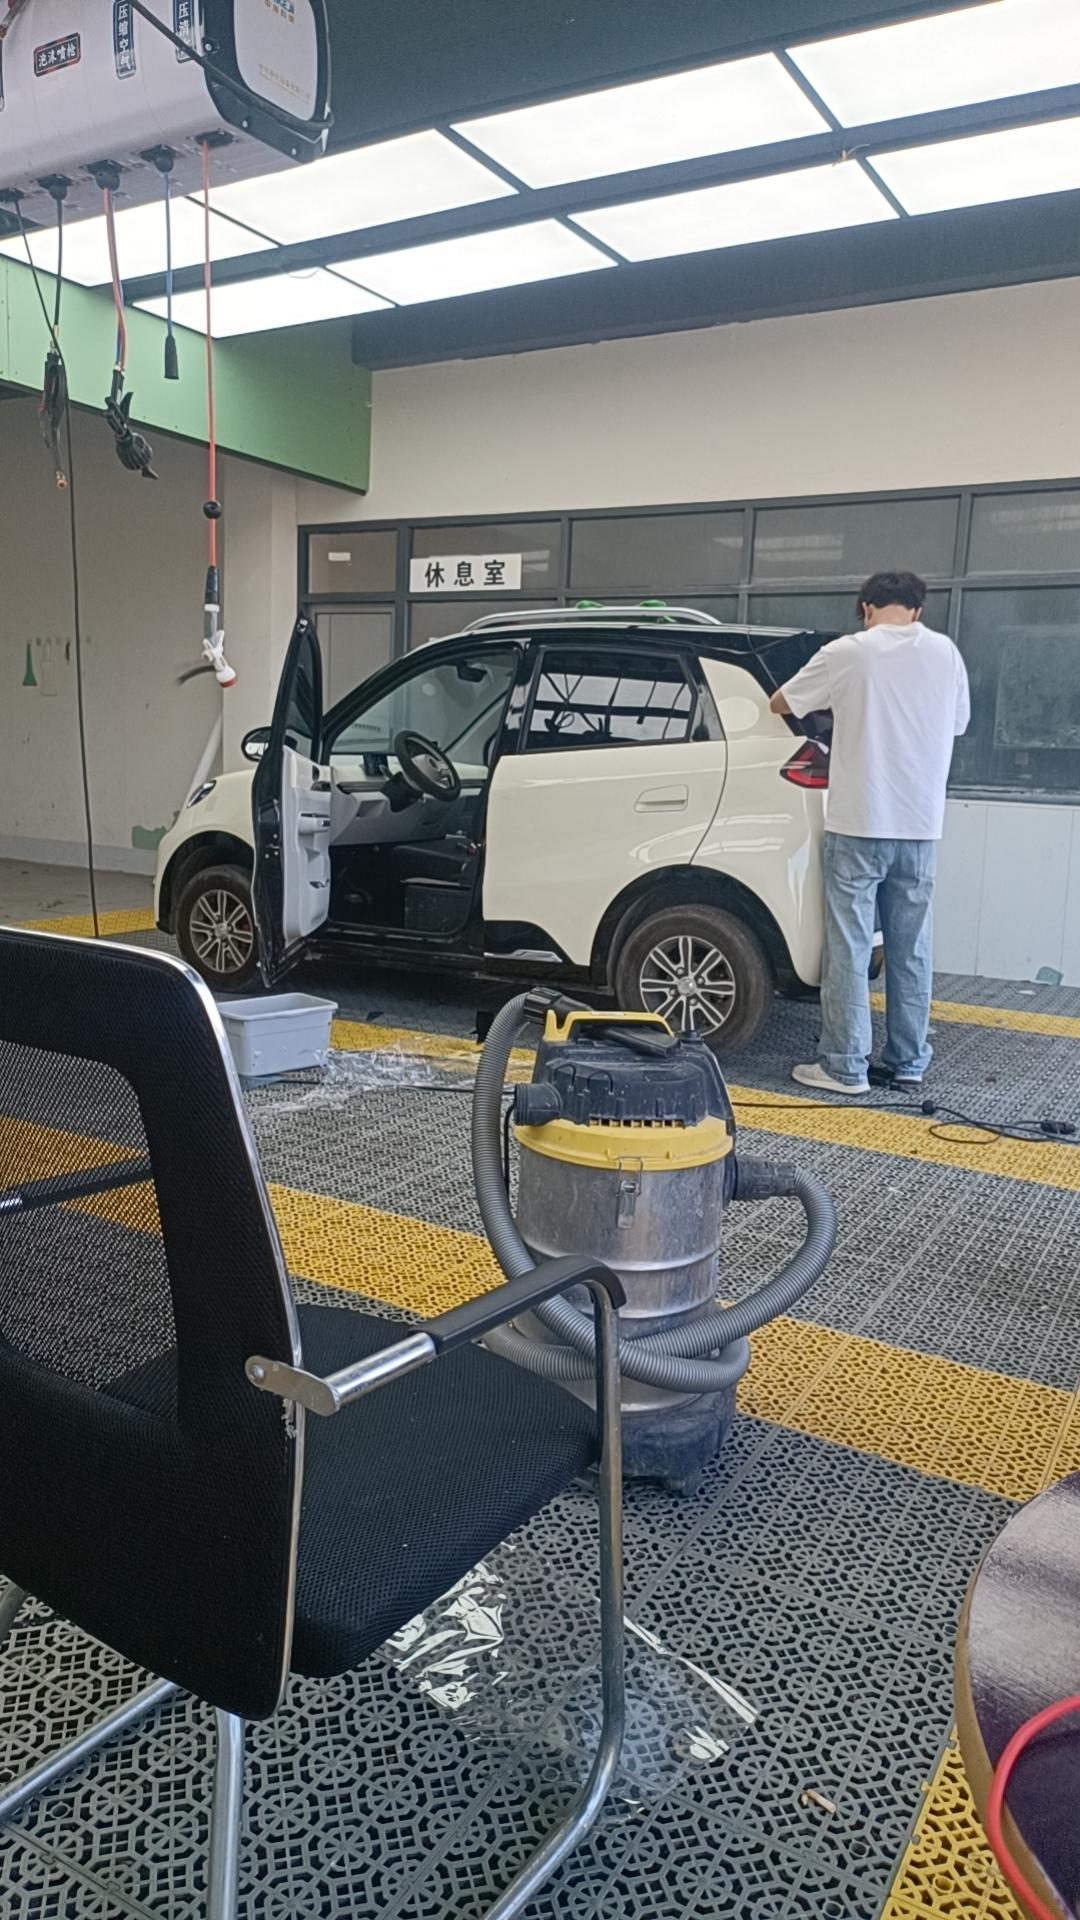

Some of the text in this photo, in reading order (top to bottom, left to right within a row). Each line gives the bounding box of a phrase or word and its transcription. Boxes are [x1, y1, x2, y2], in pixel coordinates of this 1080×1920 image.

[38, 43, 76, 68] 泡沫喷枪
[425, 560, 505, 588] 休息室
